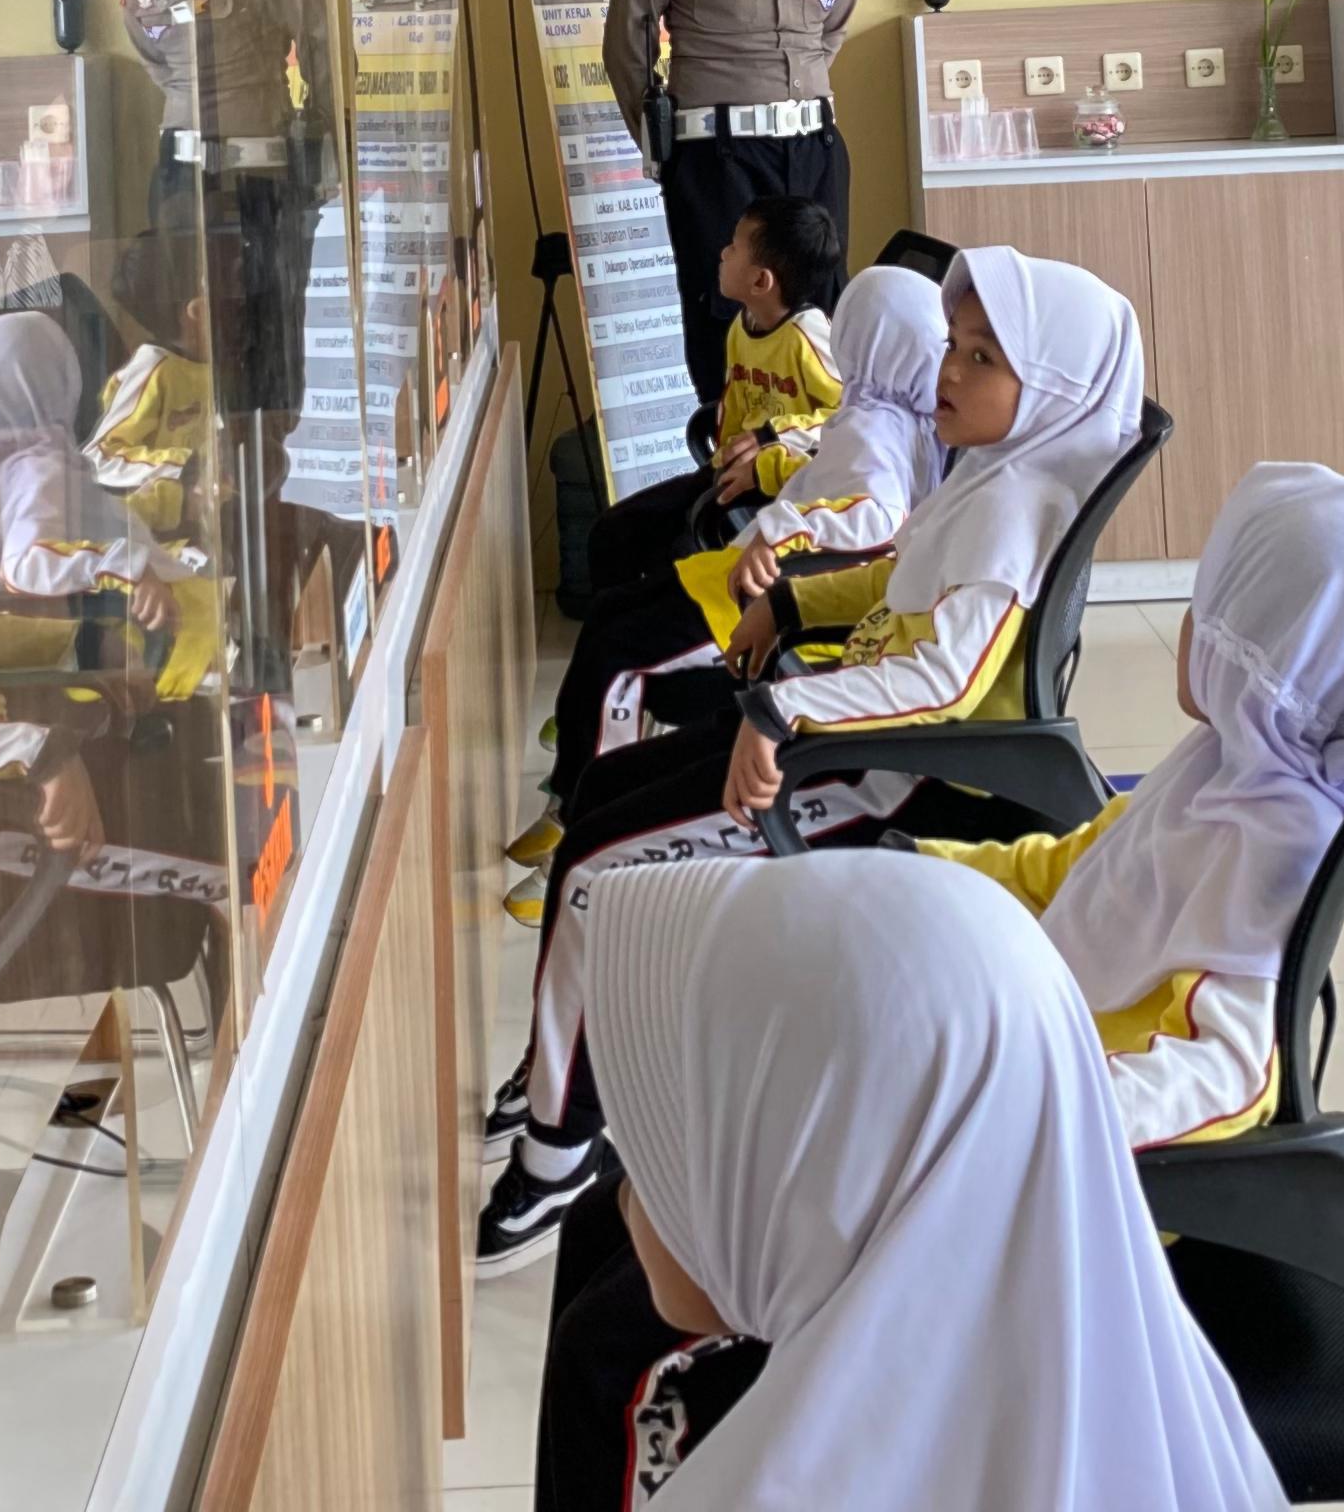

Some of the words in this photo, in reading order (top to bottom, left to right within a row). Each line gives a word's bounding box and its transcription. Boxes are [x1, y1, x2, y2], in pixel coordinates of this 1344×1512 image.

[542, 9, 562, 22] UNIT
[565, 8, 591, 20] KERJA
[545, 23, 581, 36] ALOKASI
[600, 229, 626, 245] Layanan
[628, 225, 650, 239] Umum
